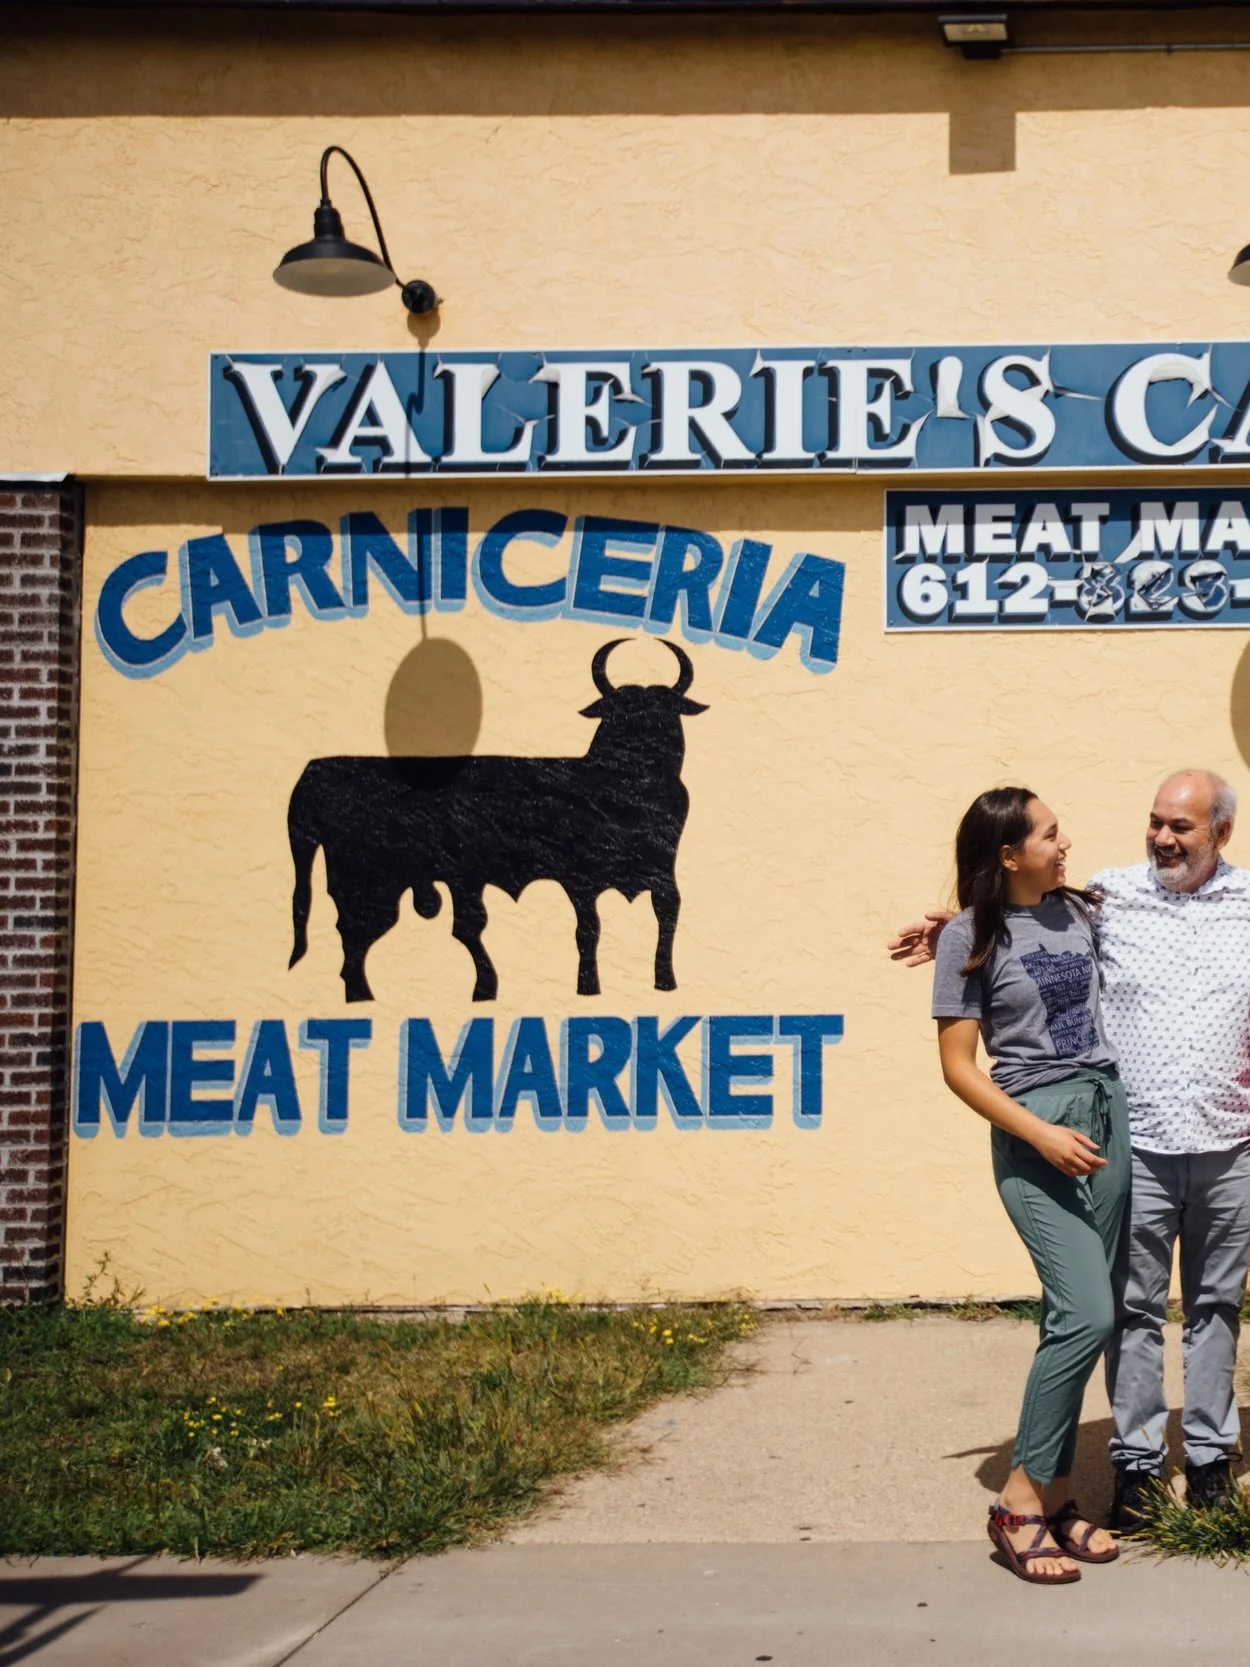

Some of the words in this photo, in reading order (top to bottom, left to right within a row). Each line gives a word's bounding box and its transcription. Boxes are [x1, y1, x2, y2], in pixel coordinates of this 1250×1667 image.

[227, 348, 1057, 469] VALERIE'S
[898, 502, 1110, 558] MEAT
[94, 507, 846, 679] CARNICERIA
[73, 1018, 372, 1138] MEAT
[399, 1014, 845, 1134] MARKET
[1050, 1021, 1066, 1032] AUL
